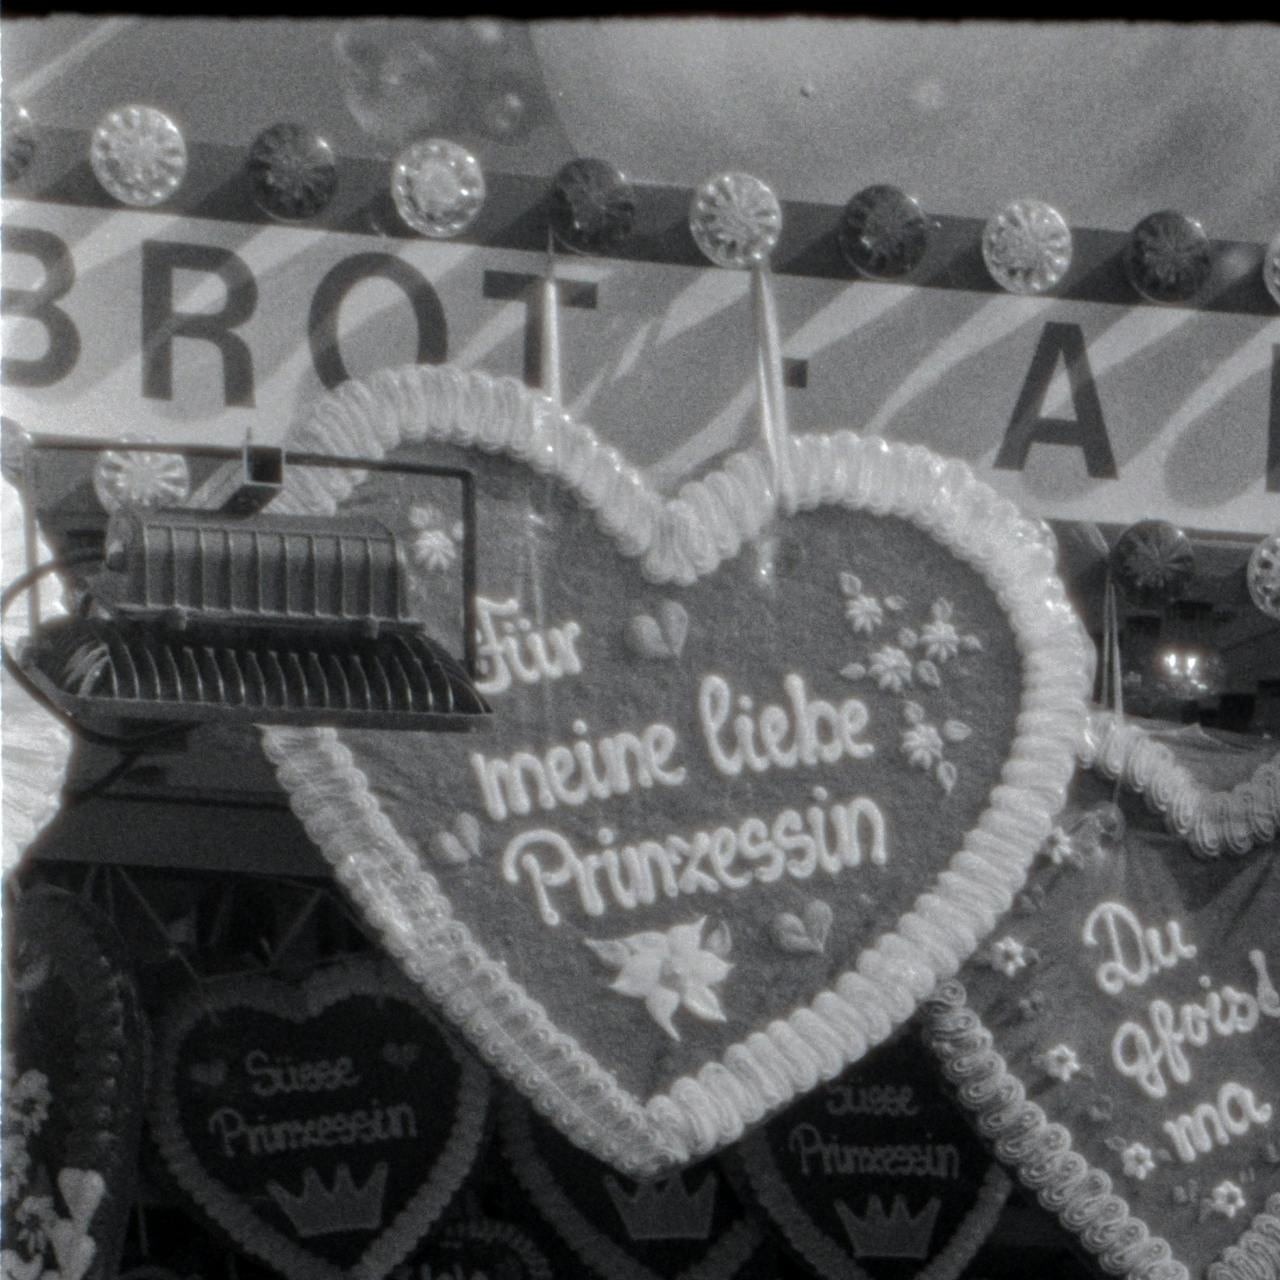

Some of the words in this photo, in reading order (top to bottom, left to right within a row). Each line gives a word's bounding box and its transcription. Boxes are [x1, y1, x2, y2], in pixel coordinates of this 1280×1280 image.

[994, 320, 1120, 481] A
[474, 595, 582, 695] Für
[471, 717, 687, 821] meine
[701, 673, 874, 776] liebe
[503, 785, 886, 926] Prinzessin
[1082, 900, 1198, 995] Du
[207, 1099, 418, 1158] Prinzessin
[1162, 1080, 1274, 1163] ma
